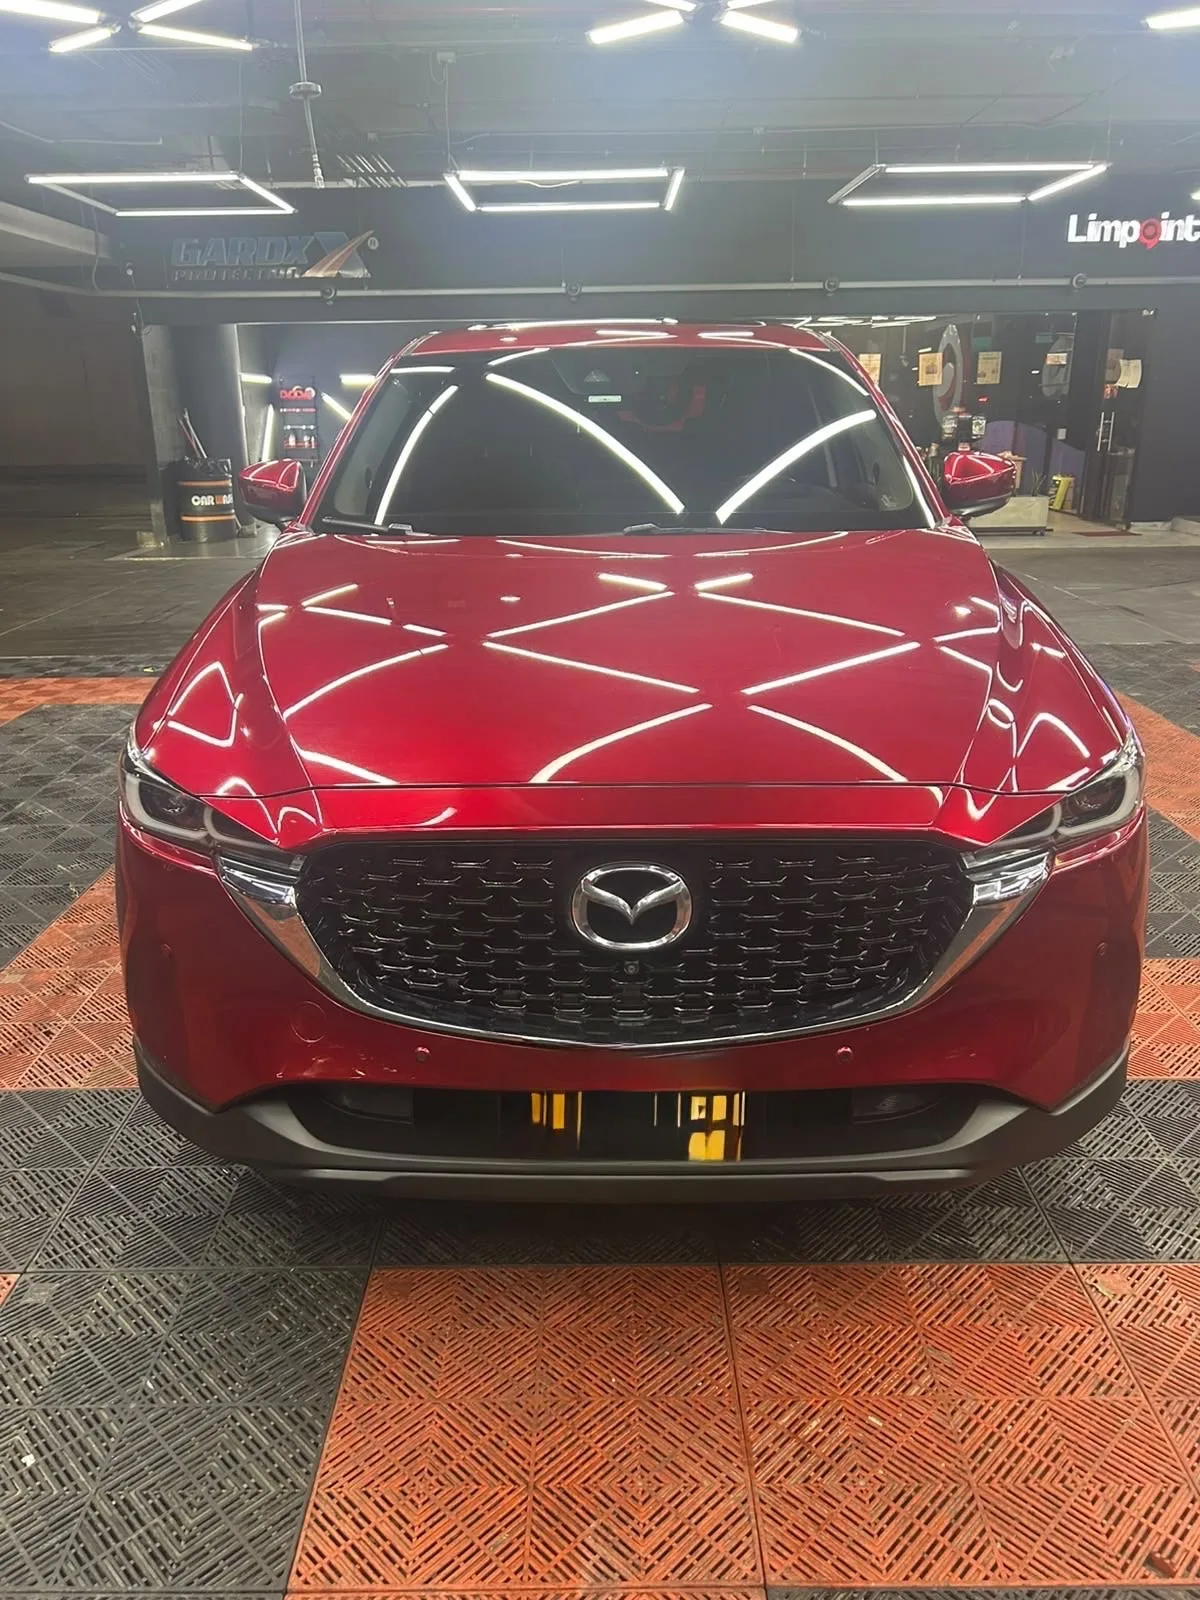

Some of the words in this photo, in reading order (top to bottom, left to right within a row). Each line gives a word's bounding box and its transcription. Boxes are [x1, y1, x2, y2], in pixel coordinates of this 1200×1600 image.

[1067, 211, 1200, 249] Limpoint
[171, 236, 315, 266] GARDX
[191, 495, 215, 506] CAR
